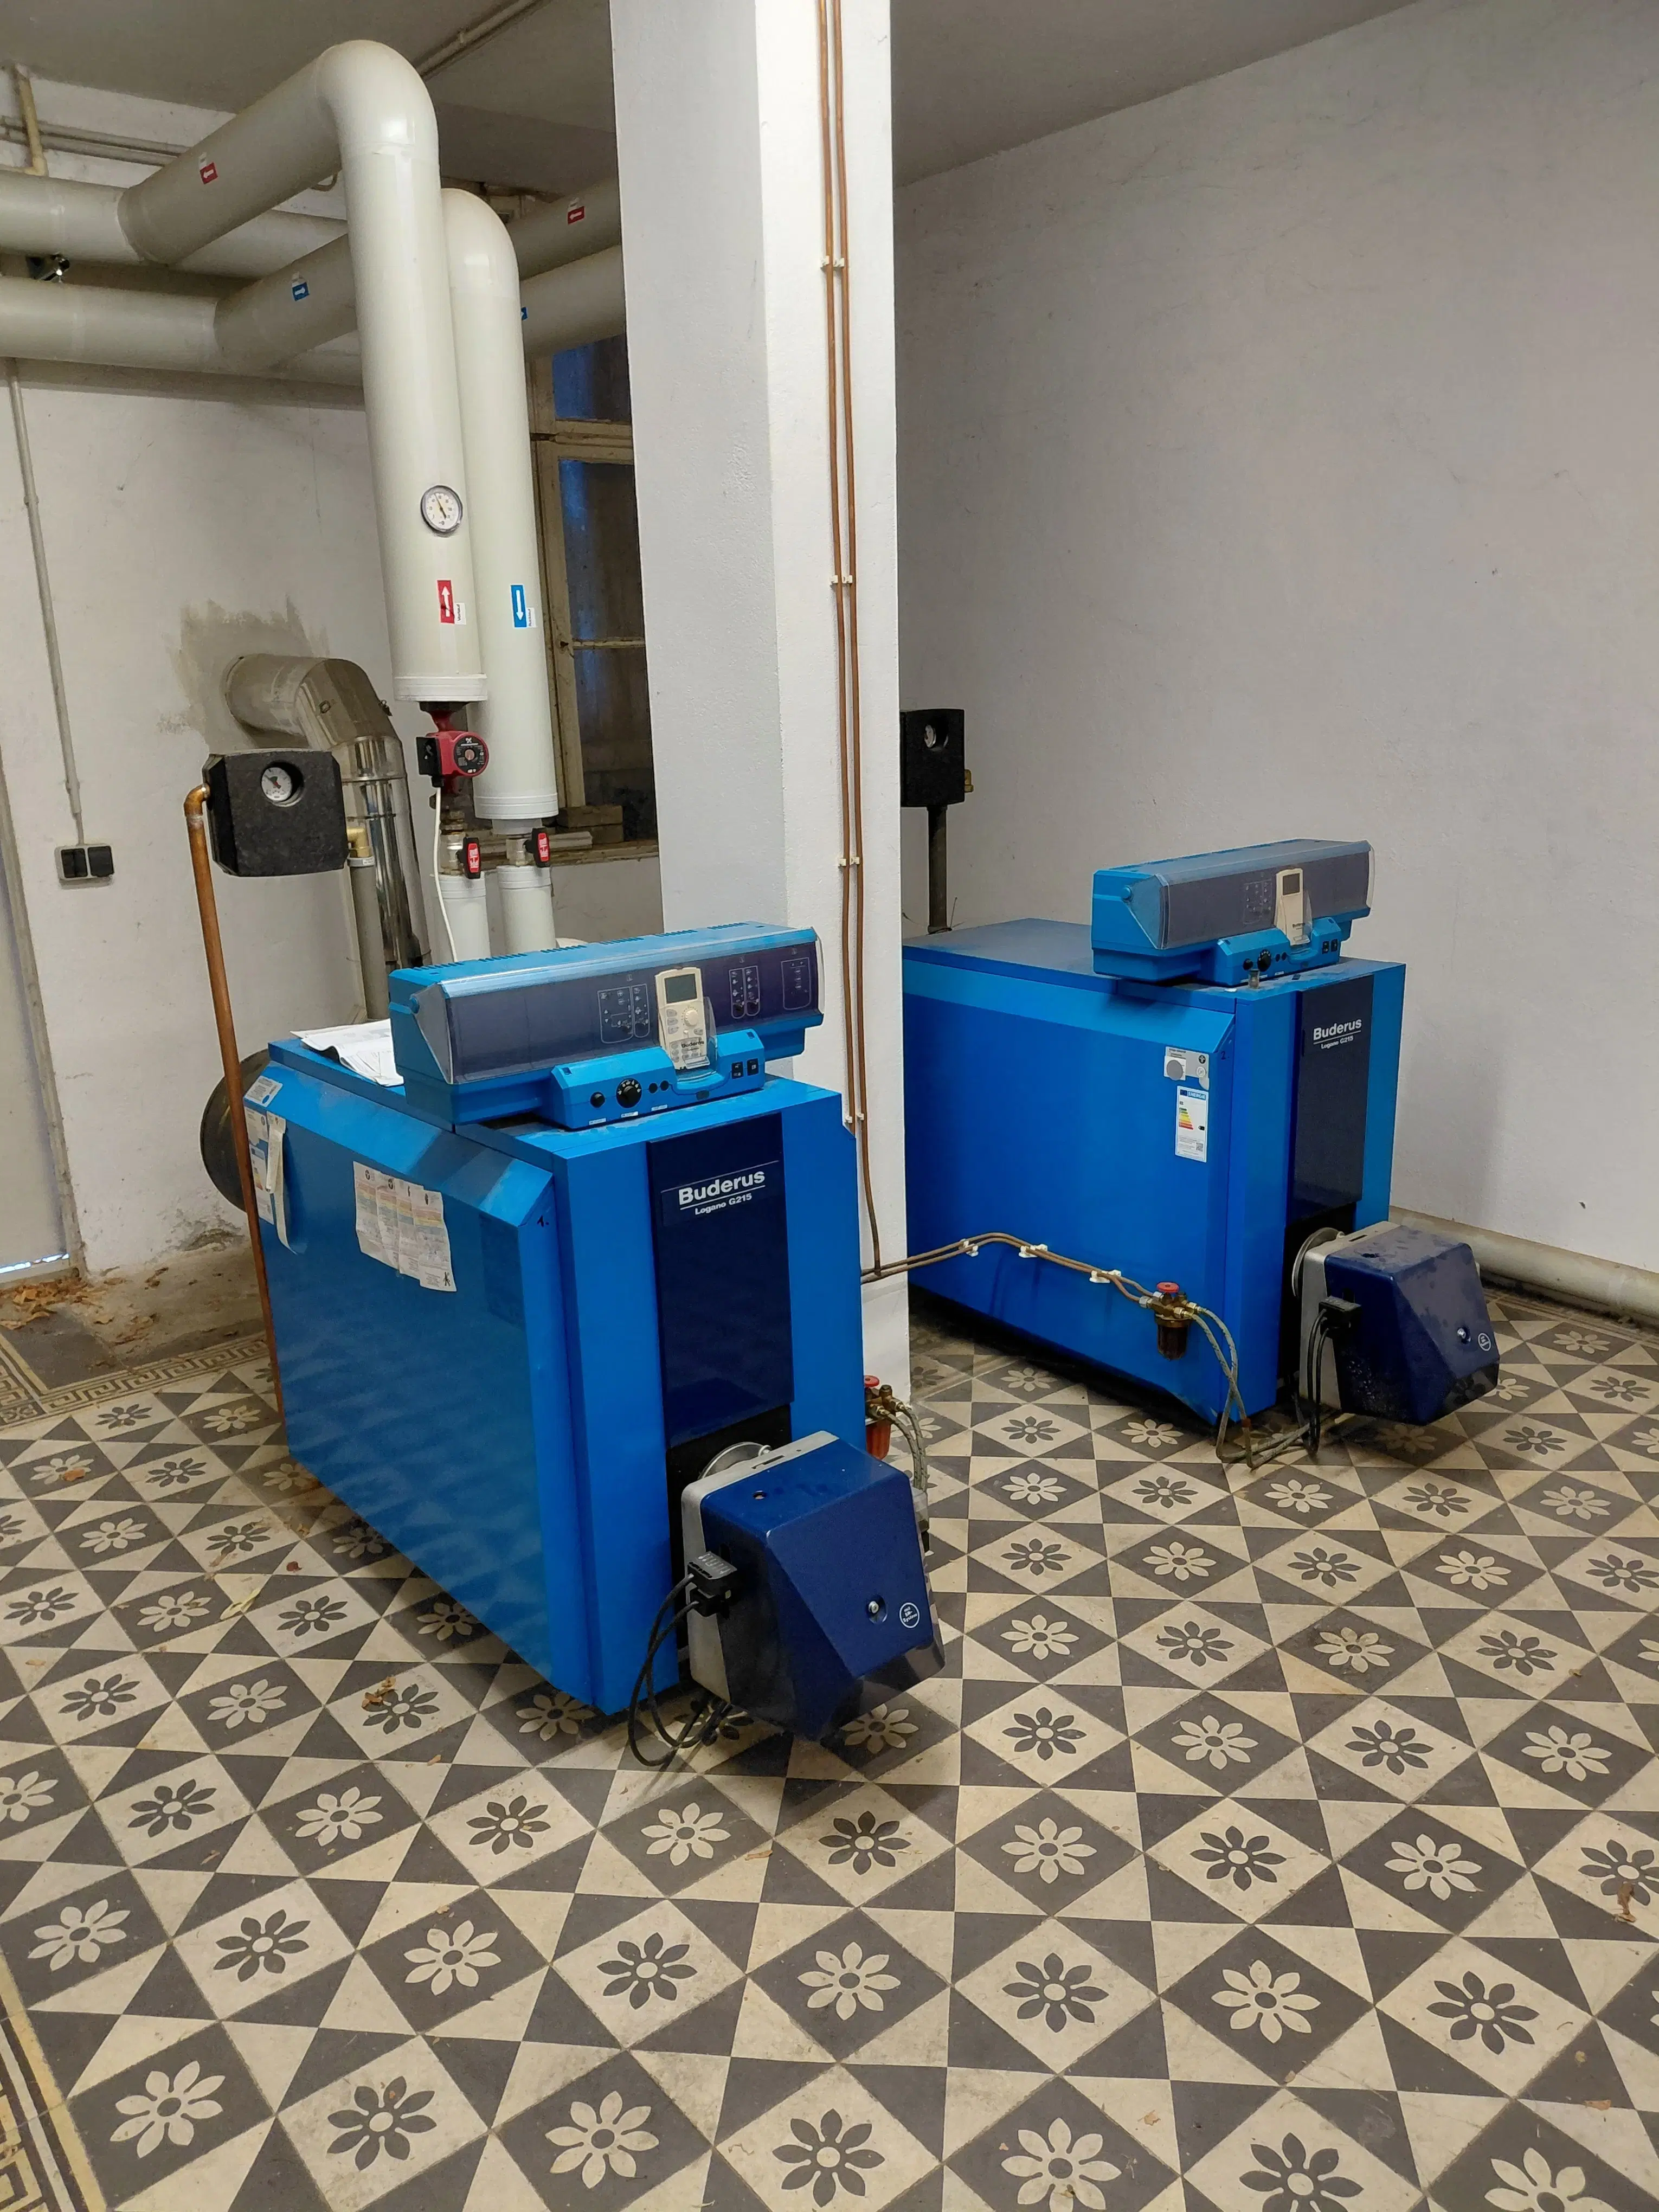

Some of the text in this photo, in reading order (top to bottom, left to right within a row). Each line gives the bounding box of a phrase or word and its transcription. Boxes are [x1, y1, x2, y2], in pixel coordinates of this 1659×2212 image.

[1313, 1019, 1362, 1040] Buderus
[1321, 1036, 1354, 1049] Logano G215
[679, 1171, 765, 1205] Buderus
[695, 1193, 752, 1215] Logano G215
[903, 1613, 917, 1622] System
